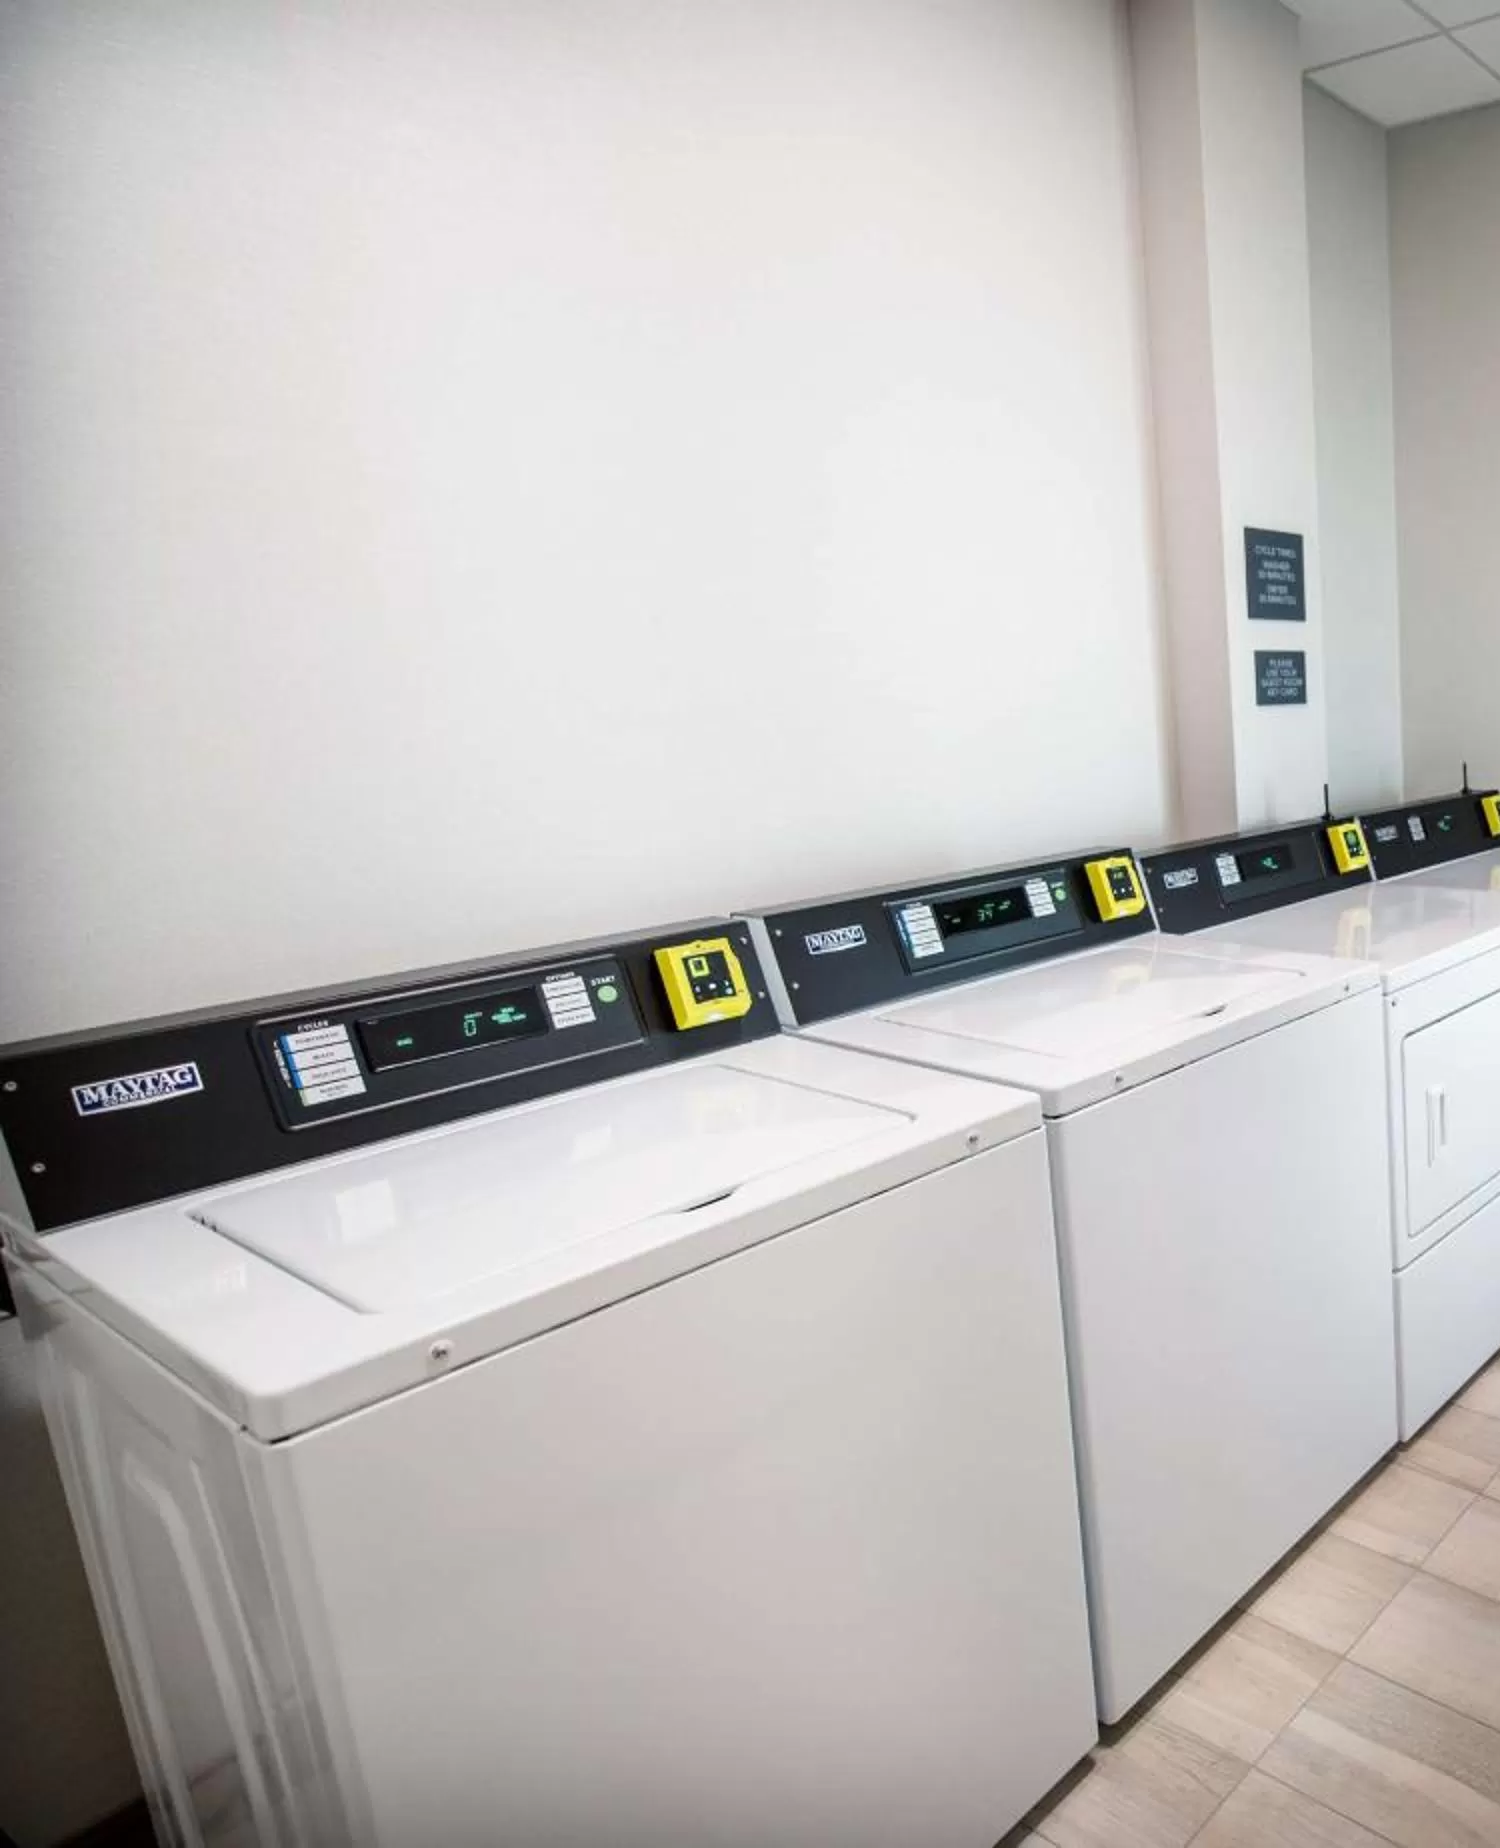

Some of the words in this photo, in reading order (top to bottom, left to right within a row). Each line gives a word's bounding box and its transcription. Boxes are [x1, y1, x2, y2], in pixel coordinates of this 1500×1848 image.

[1269, 659, 1293, 667] PLEASE
[590, 975, 616, 986] START
[80, 1066, 193, 1106] MAYTAG
